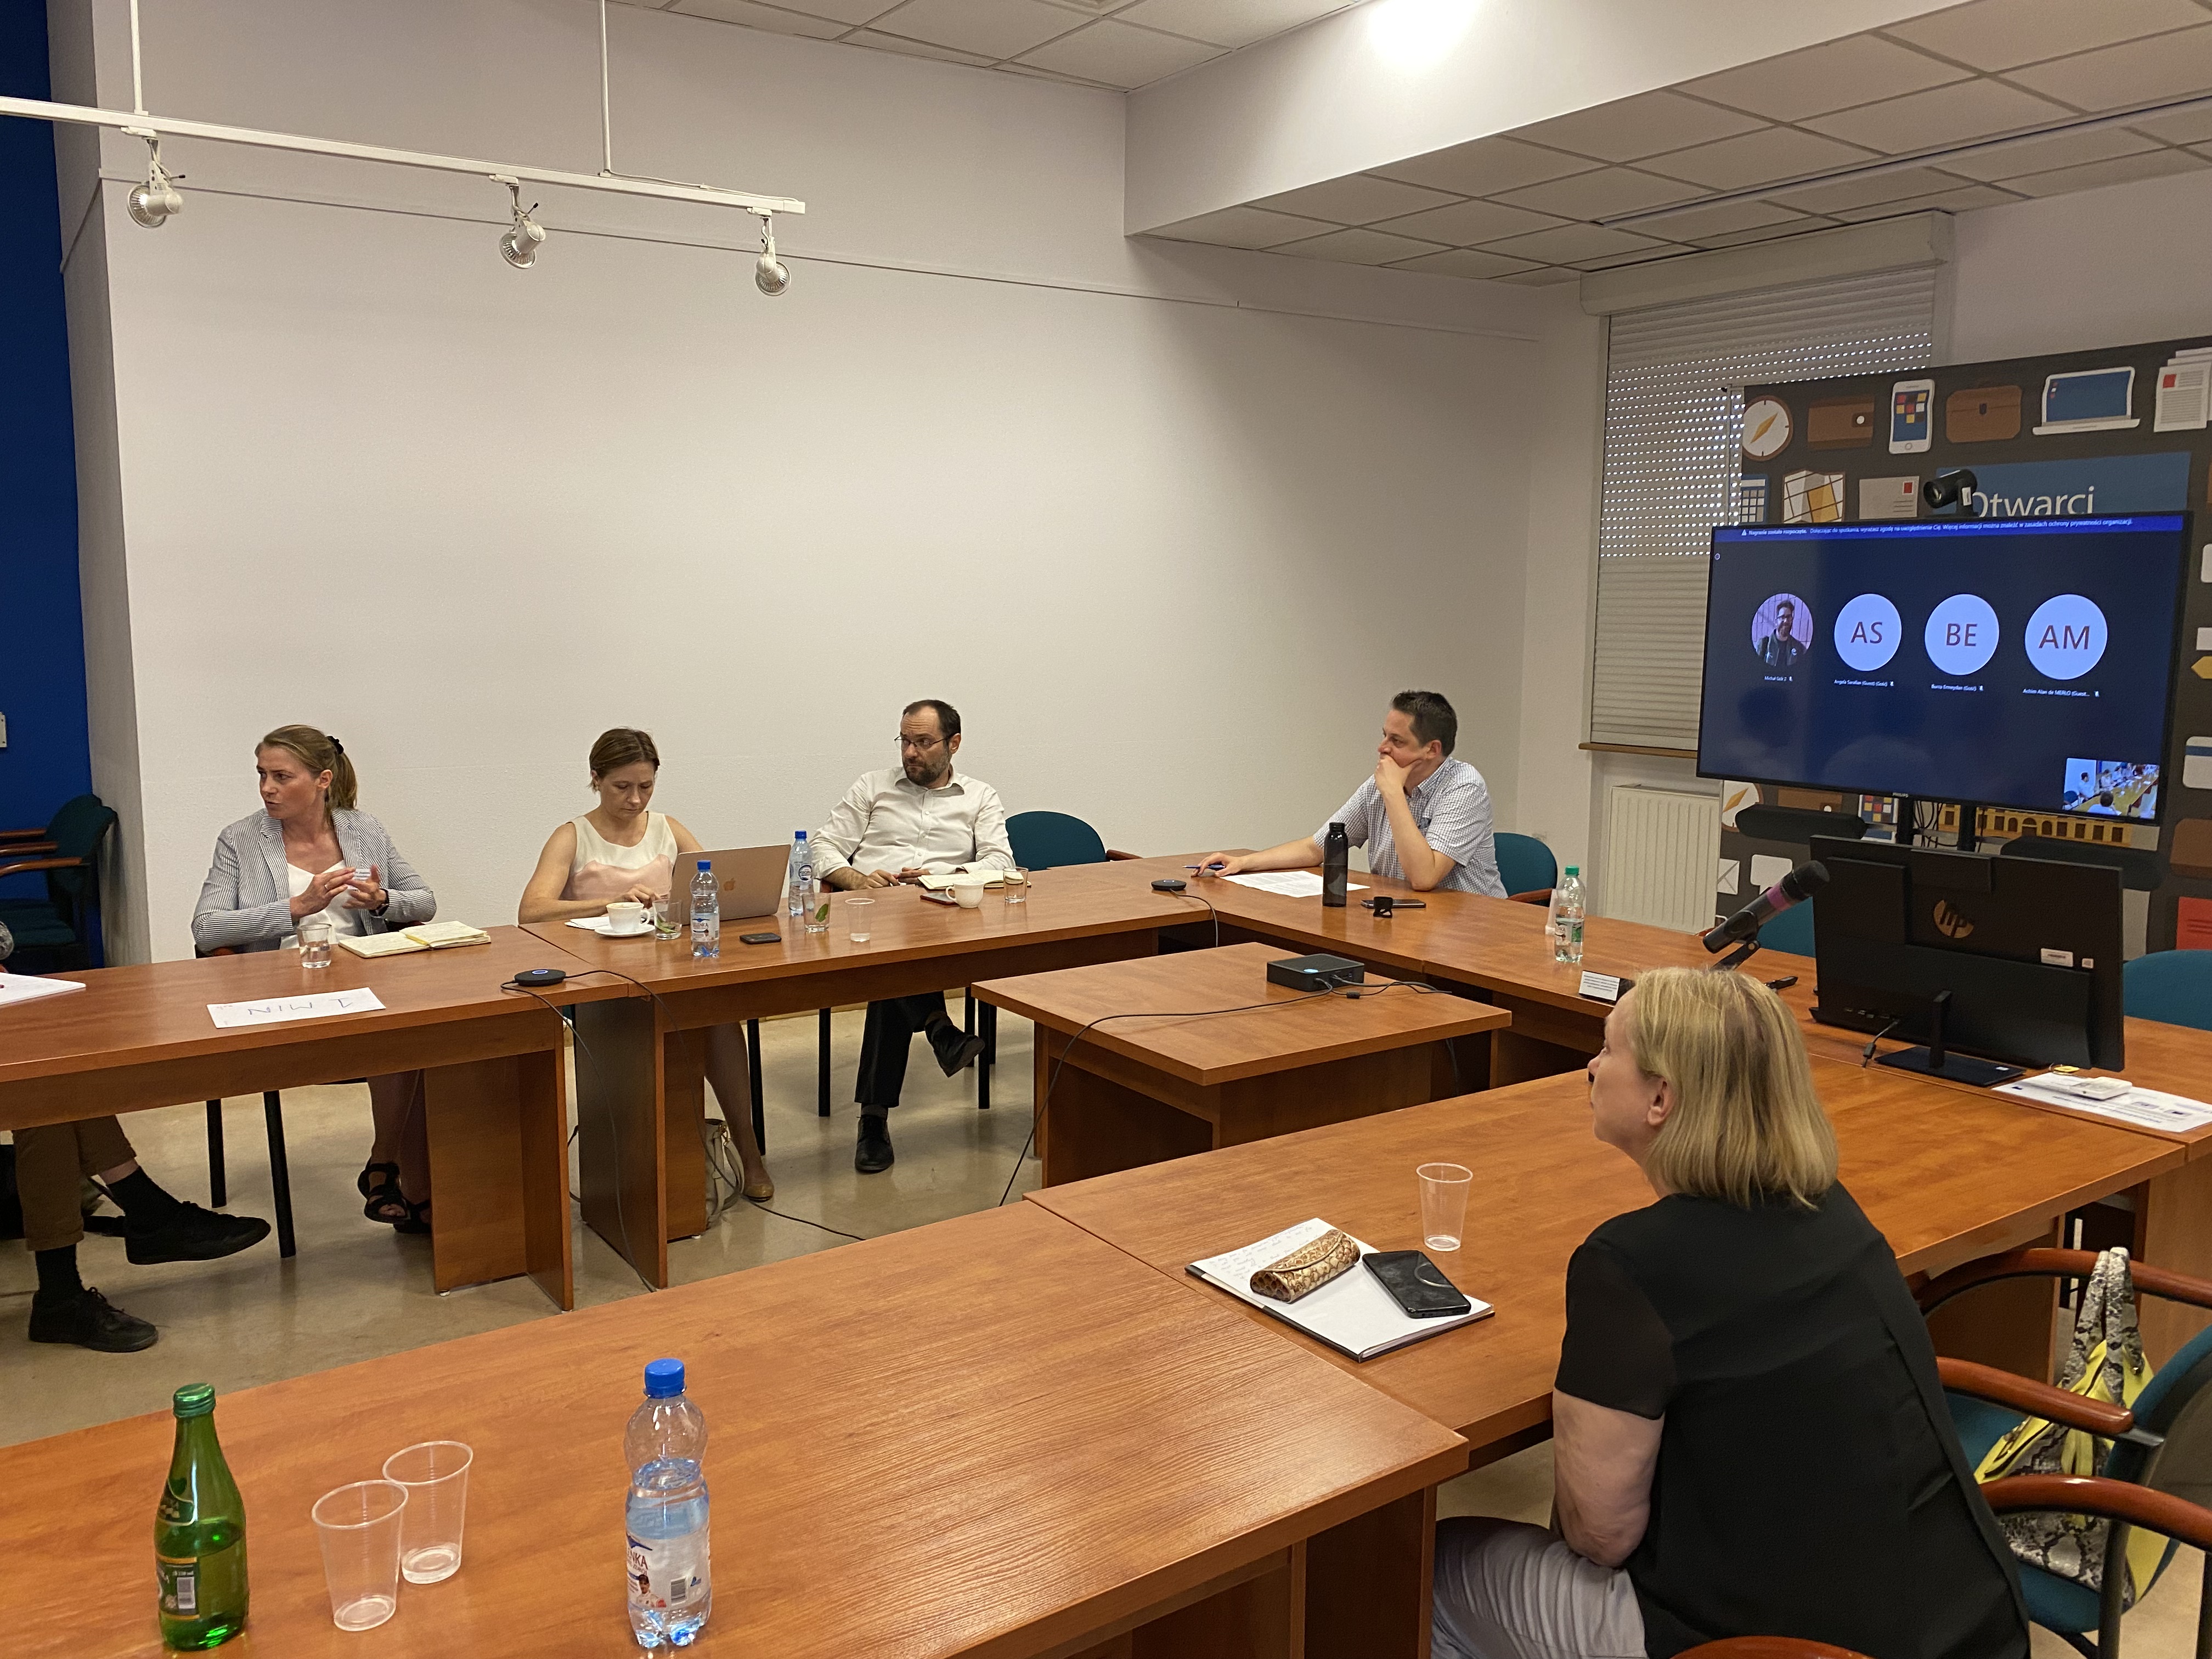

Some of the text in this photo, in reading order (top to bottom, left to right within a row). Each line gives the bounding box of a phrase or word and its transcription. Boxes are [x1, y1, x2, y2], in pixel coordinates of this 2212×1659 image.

[1850, 620, 1883, 644] AS
[1945, 623, 1978, 646] BE
[2038, 625, 2090, 650] AM
[247, 997, 353, 1015] 1 MIN
